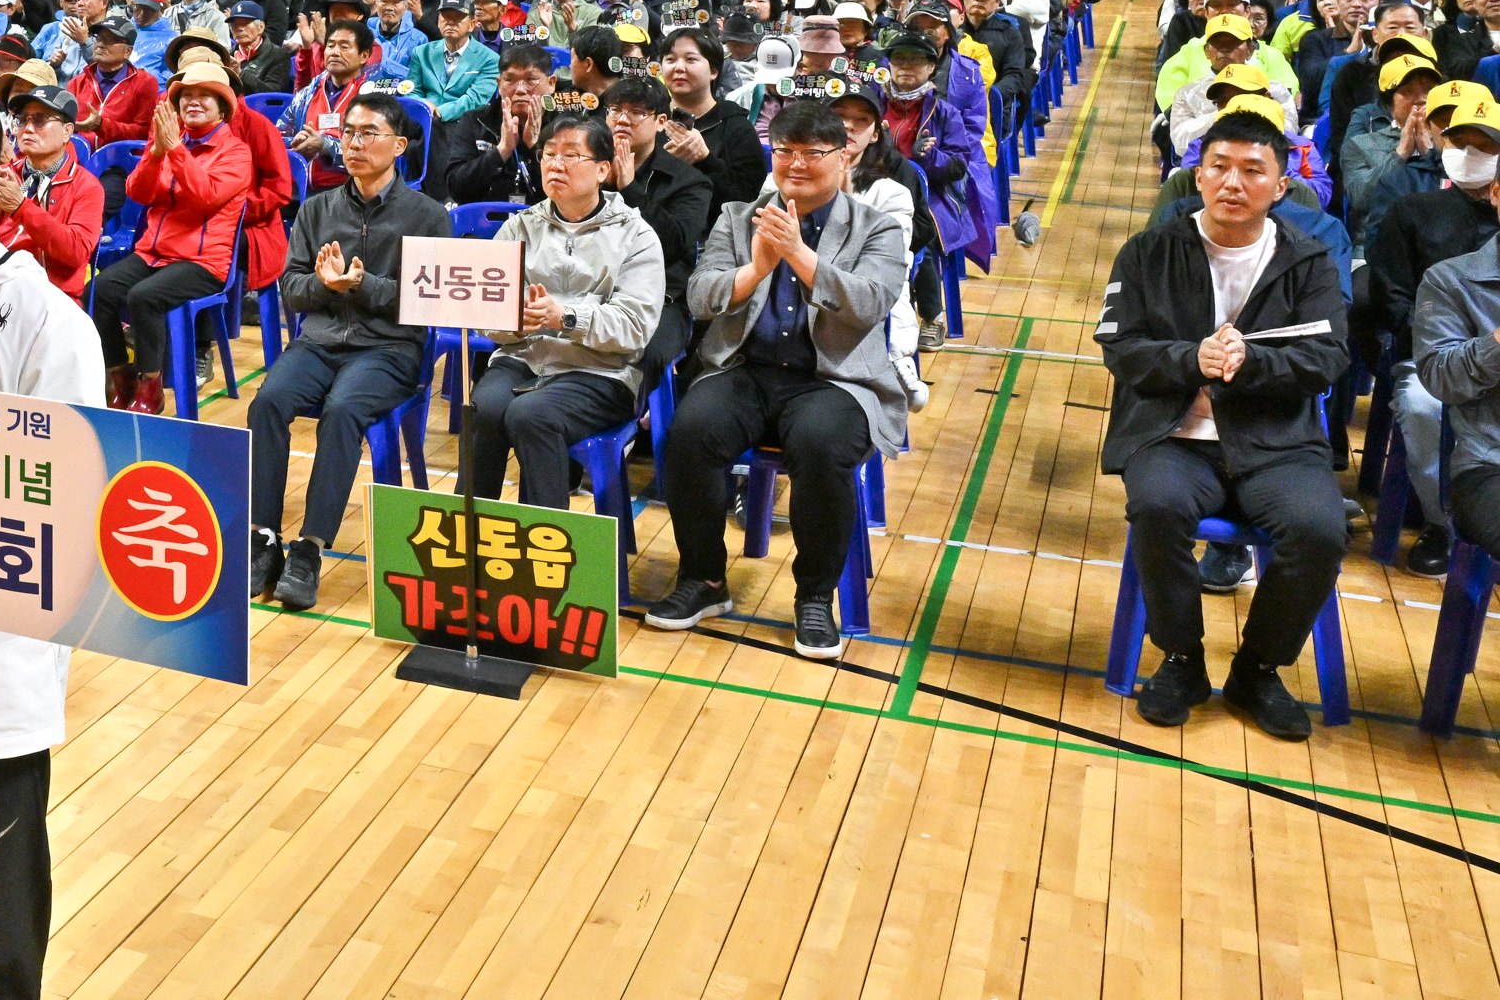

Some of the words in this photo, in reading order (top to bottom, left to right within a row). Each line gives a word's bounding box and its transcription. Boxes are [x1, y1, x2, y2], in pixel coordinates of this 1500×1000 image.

[622, 57, 649, 69] 신동읍
[554, 92, 581, 104] 신동읍
[795, 76, 826, 88] 신동읍
[412, 264, 510, 302] 신동읍
[7, 404, 52, 439] 기원
[110, 485, 210, 605] 축
[412, 508, 572, 588] 신동읍
